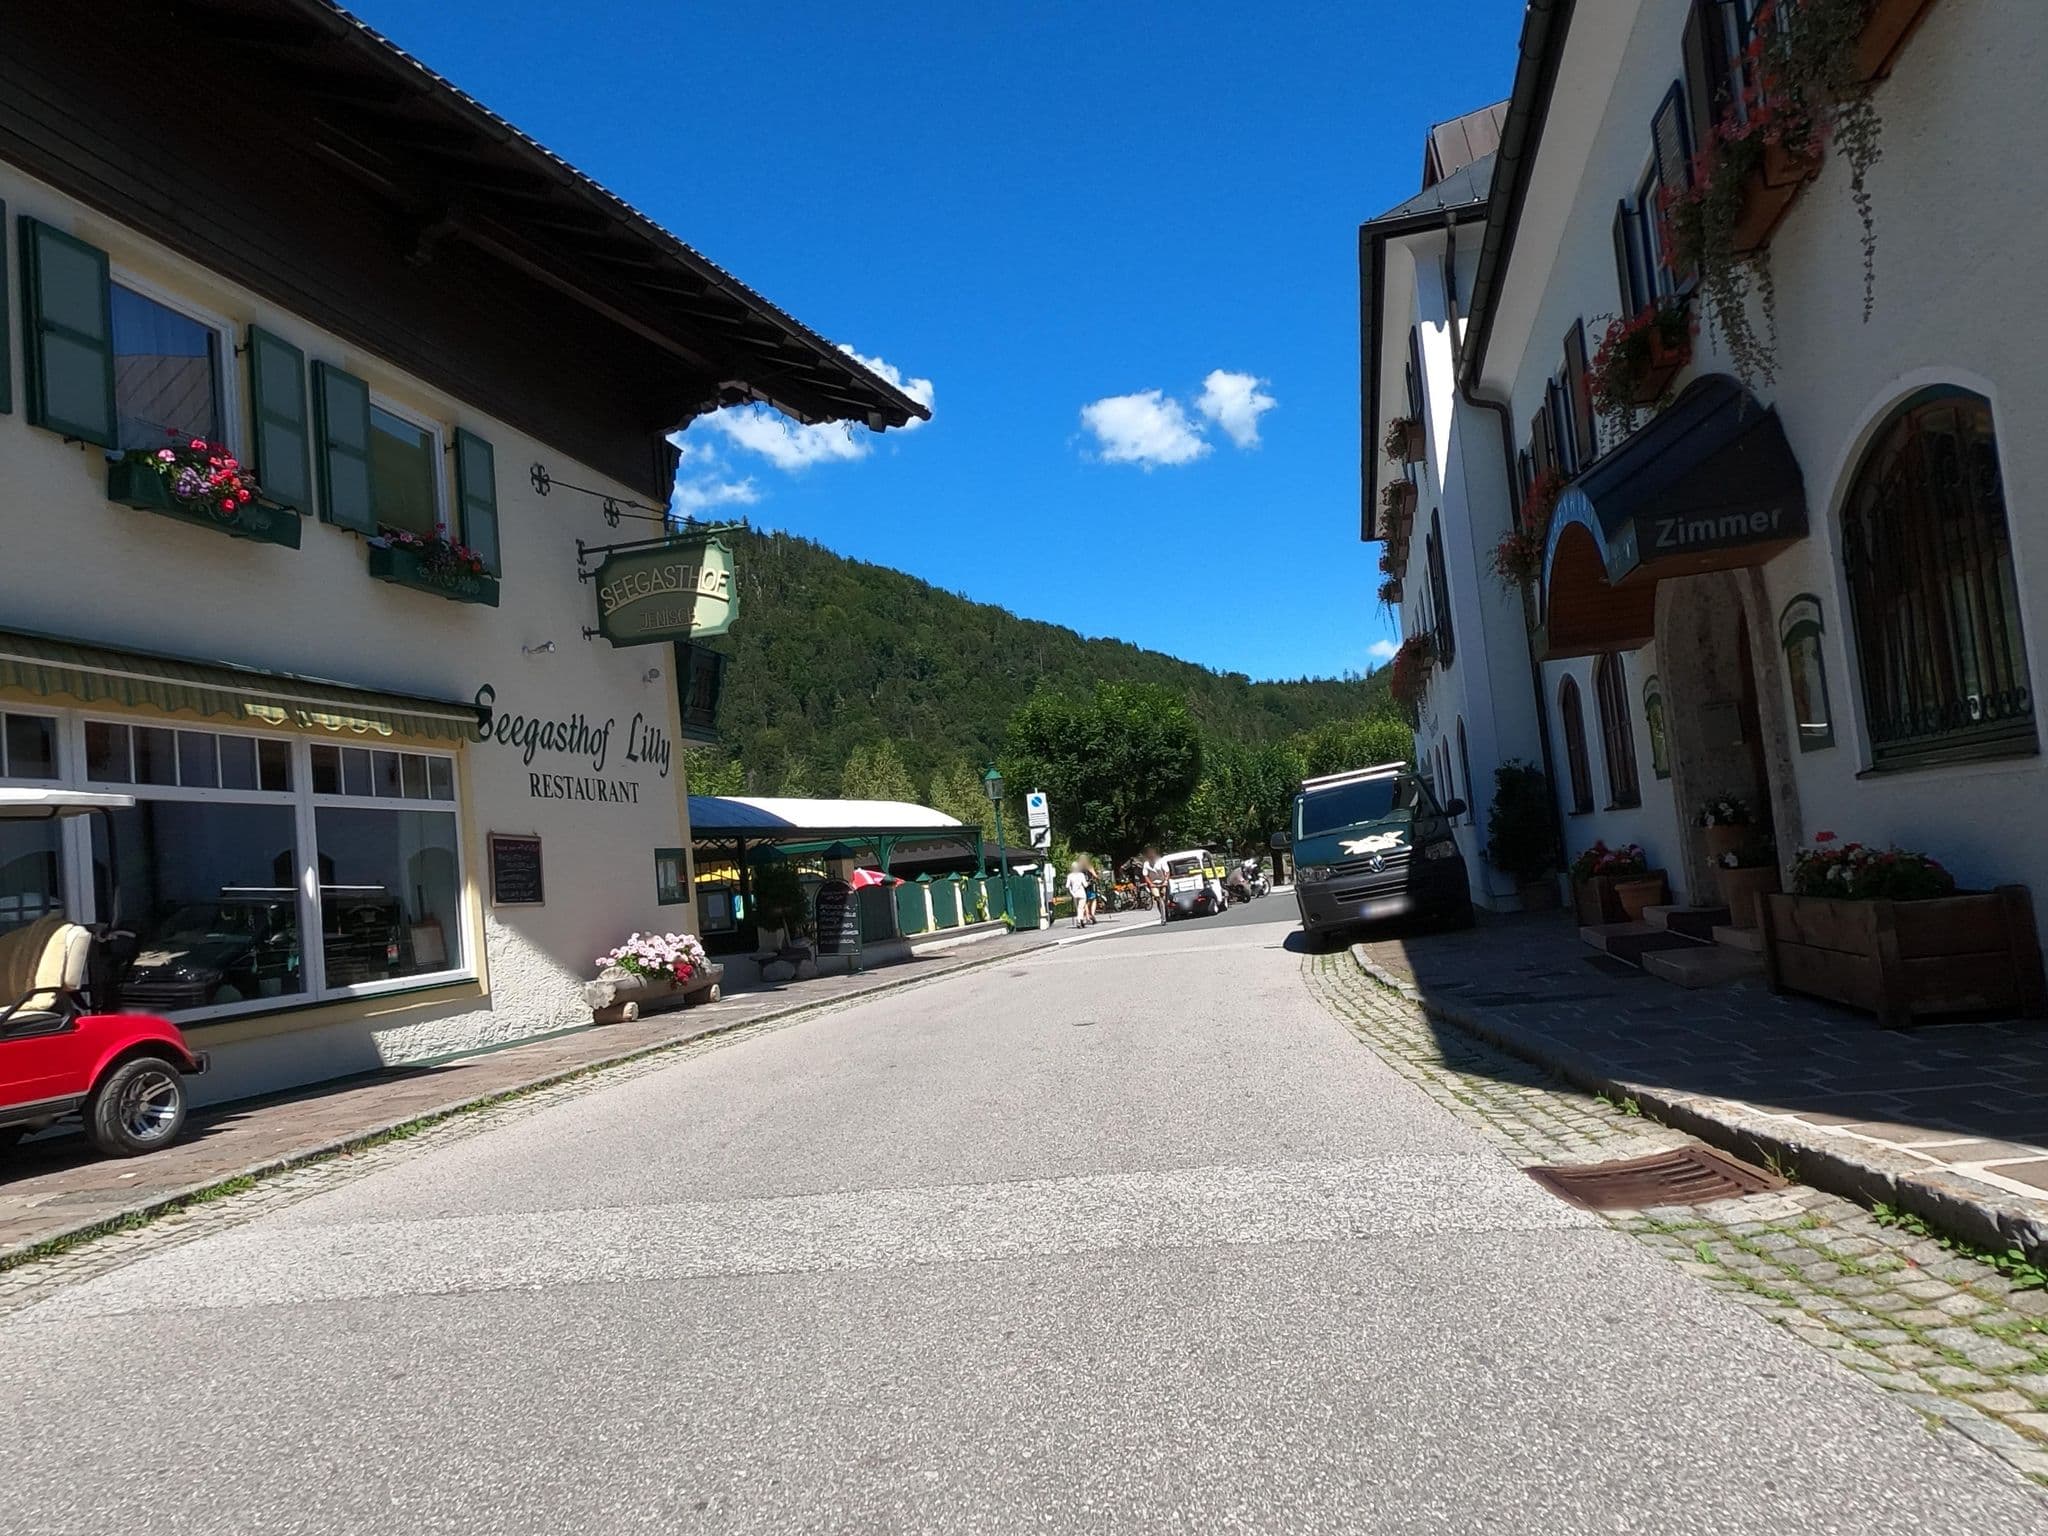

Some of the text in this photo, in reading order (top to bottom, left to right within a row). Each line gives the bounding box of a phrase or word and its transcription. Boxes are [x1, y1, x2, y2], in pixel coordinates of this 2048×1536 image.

[1655, 508, 1783, 548] Zimmer
[600, 564, 730, 609] SEEGASTHOF
[474, 683, 672, 779] Seegasthof Lilly
[528, 772, 640, 804] RESTAURANT
